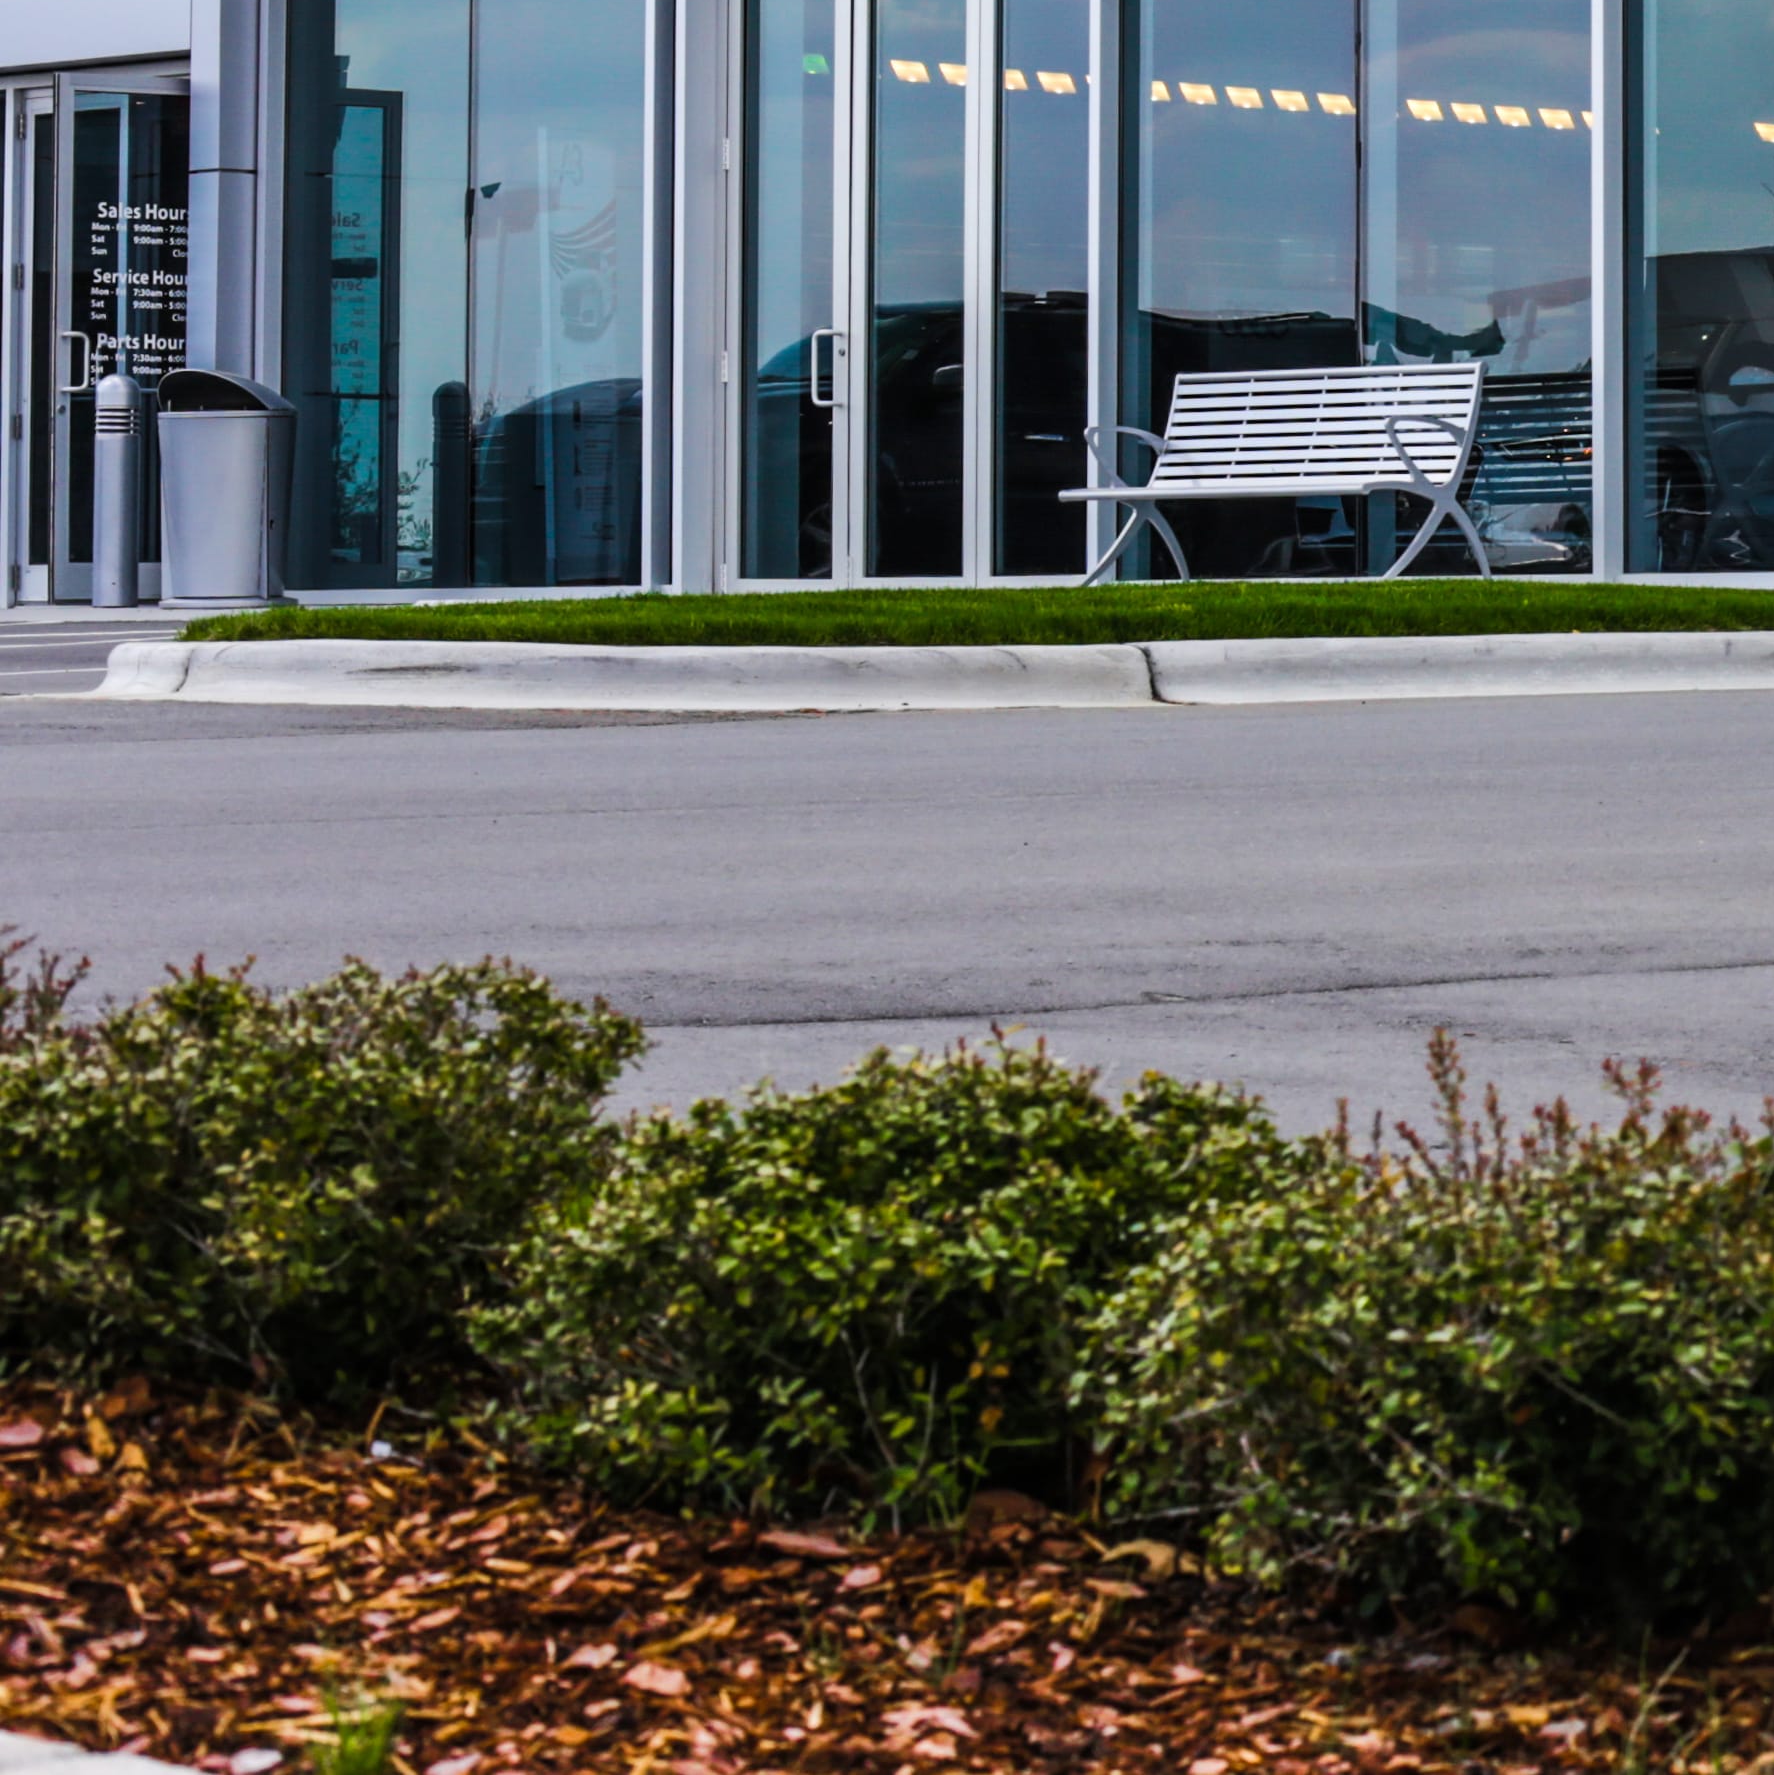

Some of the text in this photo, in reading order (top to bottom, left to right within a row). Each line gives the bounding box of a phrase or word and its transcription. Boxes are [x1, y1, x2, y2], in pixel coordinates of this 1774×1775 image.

[97, 201, 189, 220] Sales Hour
[91, 222, 110, 231] Mon
[91, 234, 105, 243] Sat
[91, 246, 188, 257] Sun Clo
[93, 268, 150, 285] Service
[90, 287, 109, 295] Mon
[133, 288, 163, 297] 7:30am
[90, 299, 105, 308] Sat
[132, 300, 163, 309] 9:00am
[90, 311, 187, 322] Sun Clo
[97, 333, 140, 350] Parts
[132, 353, 162, 362] 7:30am
[132, 366, 162, 375] 9:00am
